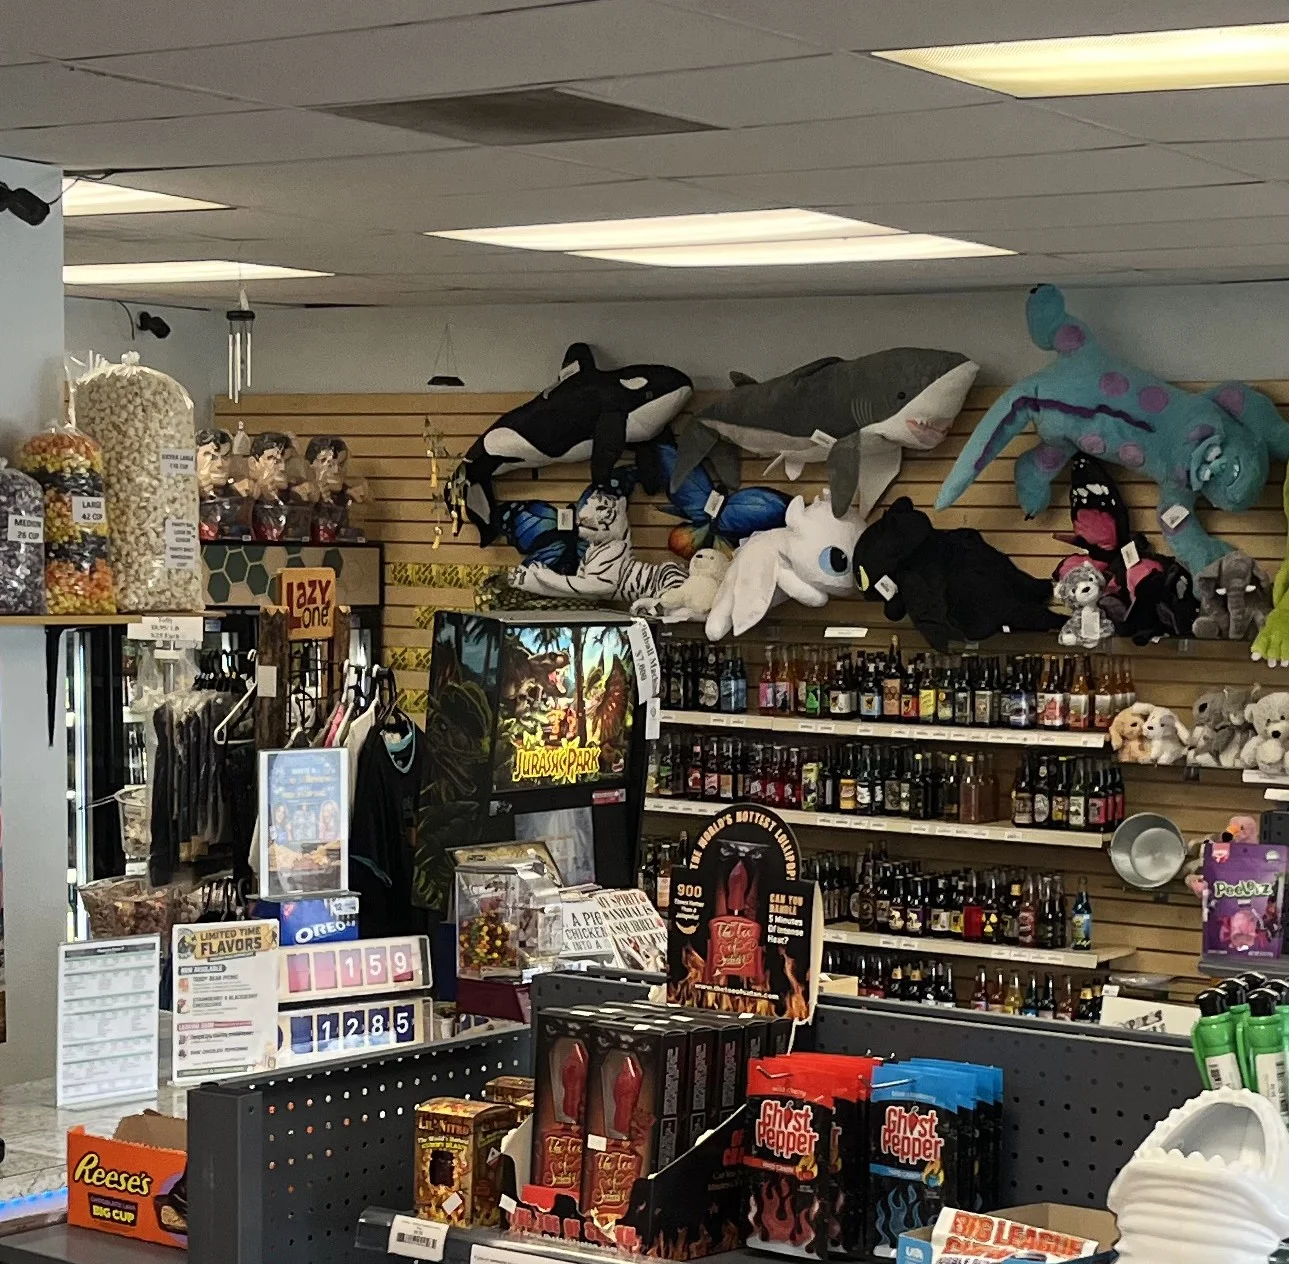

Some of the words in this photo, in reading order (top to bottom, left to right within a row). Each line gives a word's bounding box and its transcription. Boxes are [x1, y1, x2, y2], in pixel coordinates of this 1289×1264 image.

[567, 746, 601, 781] PARK
[736, 811, 777, 832] HOTTEST
[774, 828, 797, 880] LOLLIPOP!
[677, 884, 702, 898] 900
[295, 921, 345, 944] OREO
[572, 912, 581, 927] A
[200, 930, 237, 941] LIMITED
[240, 927, 261, 937] TIME
[201, 937, 262, 955] FLAVORS
[761, 1099, 813, 1132] Ghost
[756, 1120, 819, 1158] Pepper
[74, 1153, 154, 1197] Reese's
[92, 1204, 112, 1220] BIG
[113, 1207, 135, 1225] CUP
[951, 1211, 994, 1243] BIG
[993, 1220, 1084, 1258] LEAGUE
